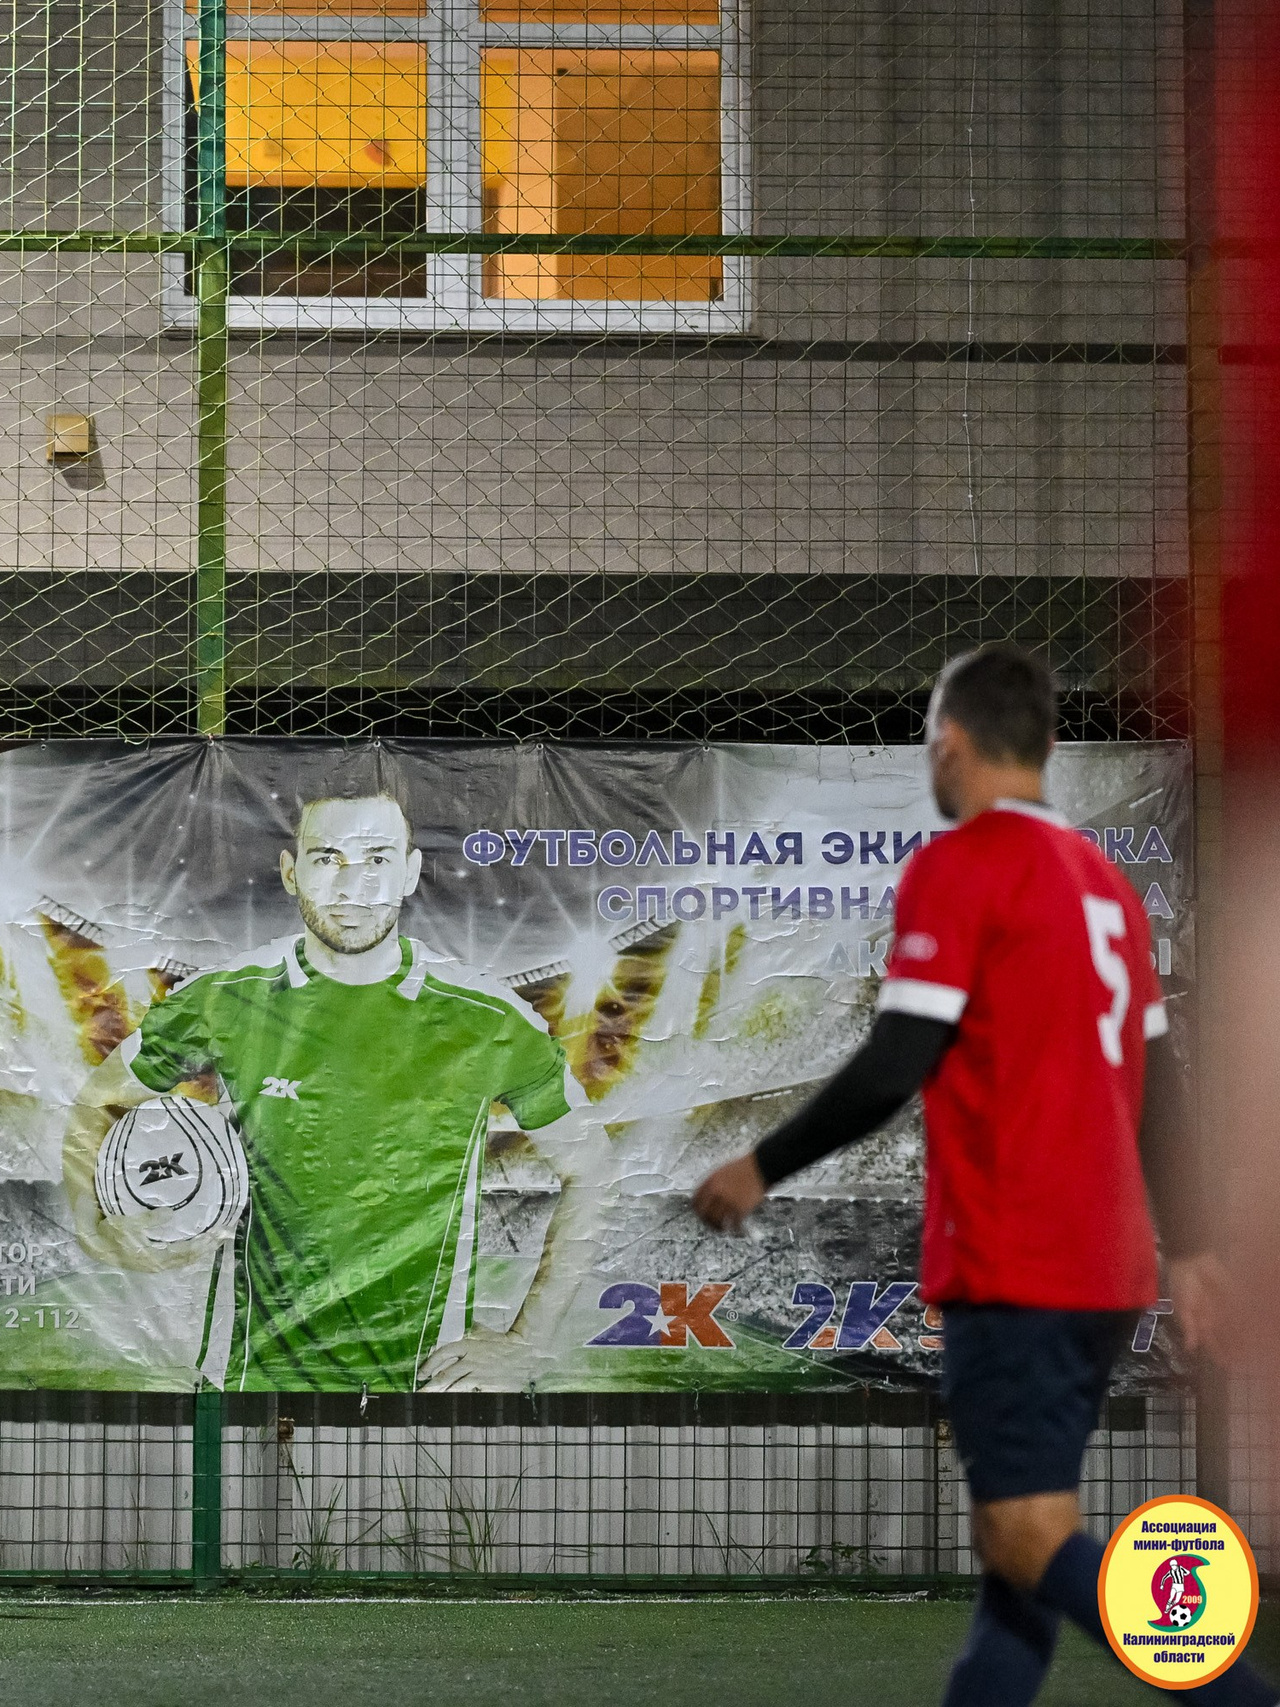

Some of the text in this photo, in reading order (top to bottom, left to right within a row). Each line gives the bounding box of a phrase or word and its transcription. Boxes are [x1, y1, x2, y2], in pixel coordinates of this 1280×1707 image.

[463, 828, 805, 867] ФУТБОЛЬНАЯ
[597, 885, 897, 922] СПОРТИВНА
[1082, 893, 1132, 1068] 5
[258, 1076, 302, 1100] 2K
[4, 1307, 80, 1329] 2-112
[783, 1281, 919, 1350] 2K
